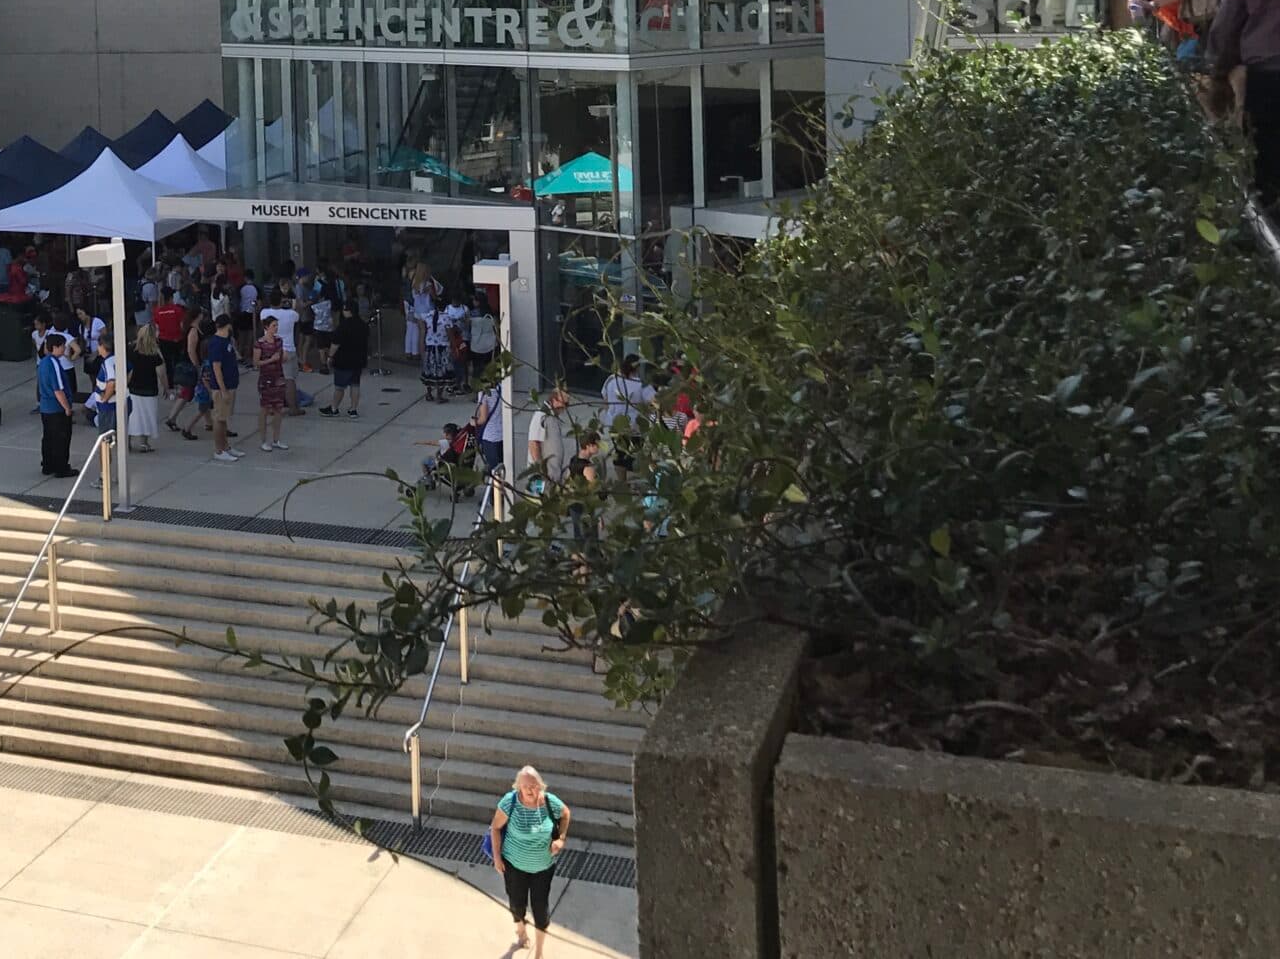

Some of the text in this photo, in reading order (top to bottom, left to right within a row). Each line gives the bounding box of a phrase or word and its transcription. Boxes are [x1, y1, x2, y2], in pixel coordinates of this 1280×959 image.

[267, 5, 549, 45] SCIENCENTRE
[251, 203, 428, 223] MUSEUM SCIENCENTRE
